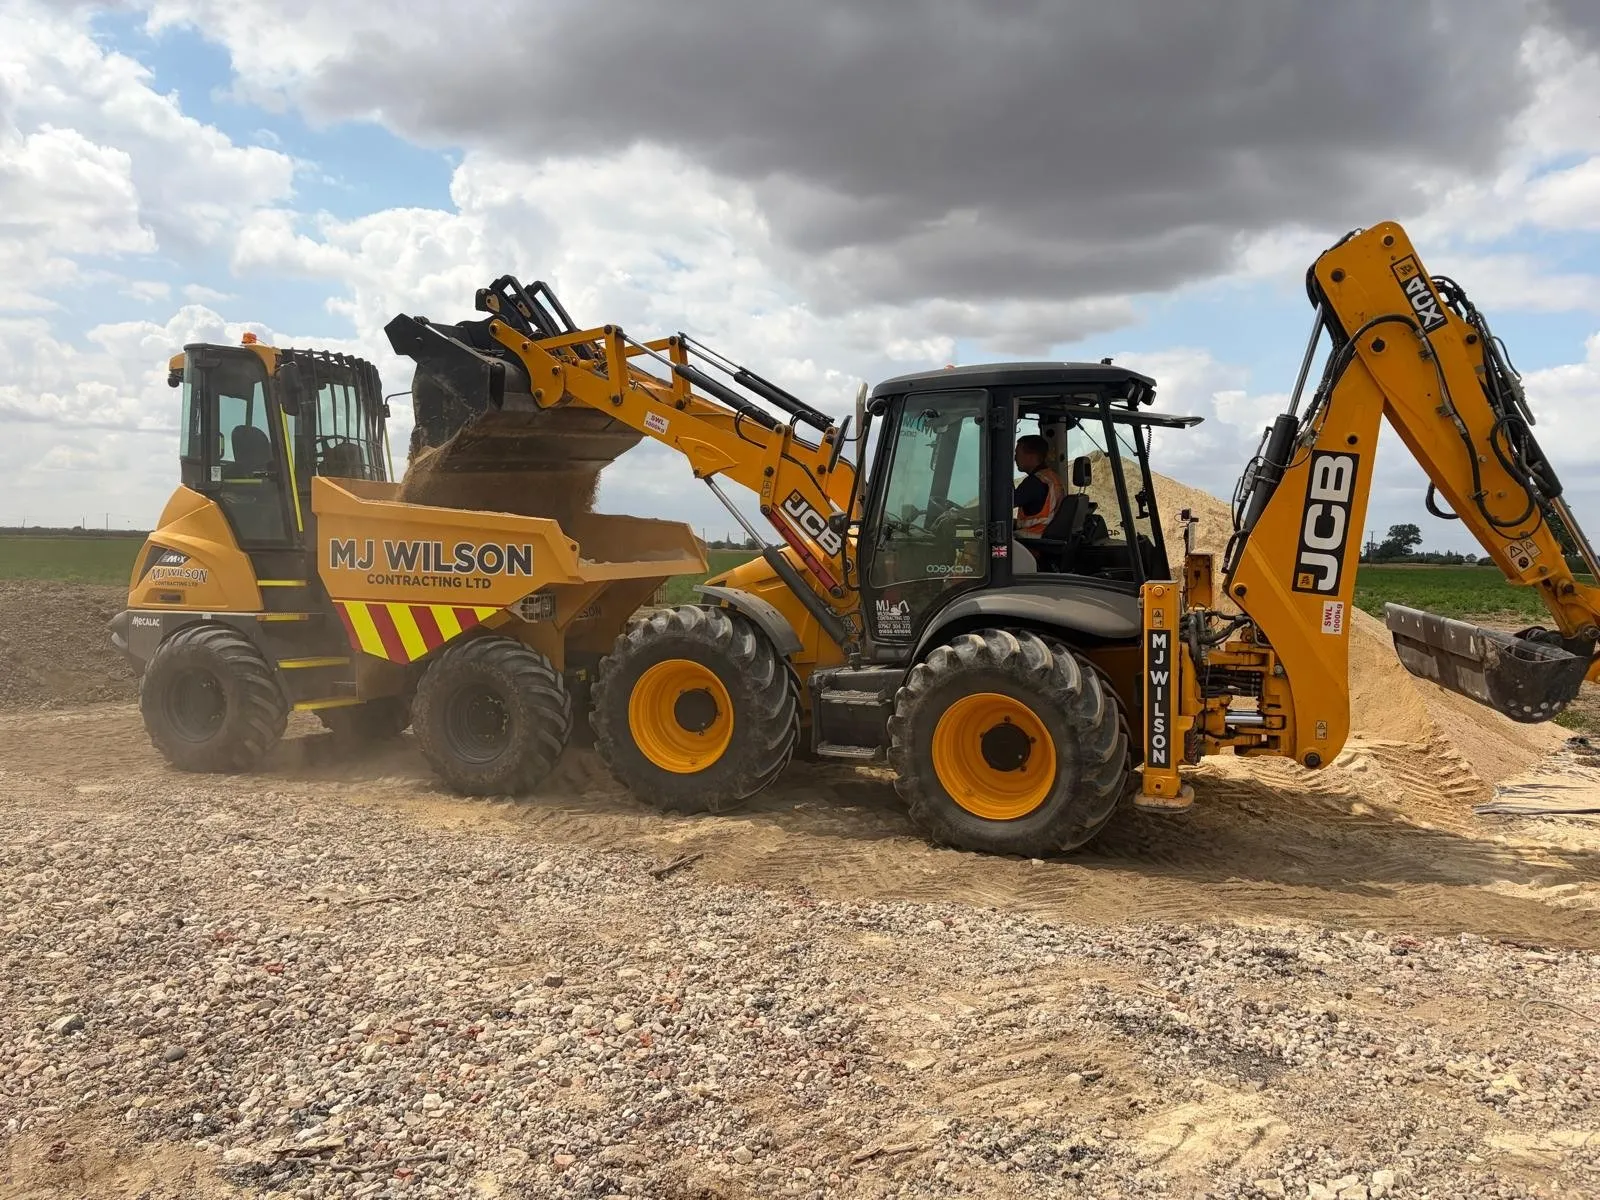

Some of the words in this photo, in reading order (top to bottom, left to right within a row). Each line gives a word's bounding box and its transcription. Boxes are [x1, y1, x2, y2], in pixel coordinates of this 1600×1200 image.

[1406, 276, 1443, 327] 4CX
[651, 415, 665, 426] SWL
[785, 499, 842, 555] JCB
[1301, 455, 1353, 591] JCB
[330, 538, 375, 571] MJ
[384, 540, 533, 577] WILSON
[152, 568, 167, 582] MJ
[168, 568, 208, 583] WILSON
[367, 573, 462, 588] CONTRACTING
[466, 577, 491, 589] LTD
[876, 599, 890, 611] MJ
[1324, 606, 1333, 627] SWL
[1333, 604, 1343, 633] 1000kg
[1152, 634, 1167, 664] MJ
[1150, 671, 1169, 764] WILSON
